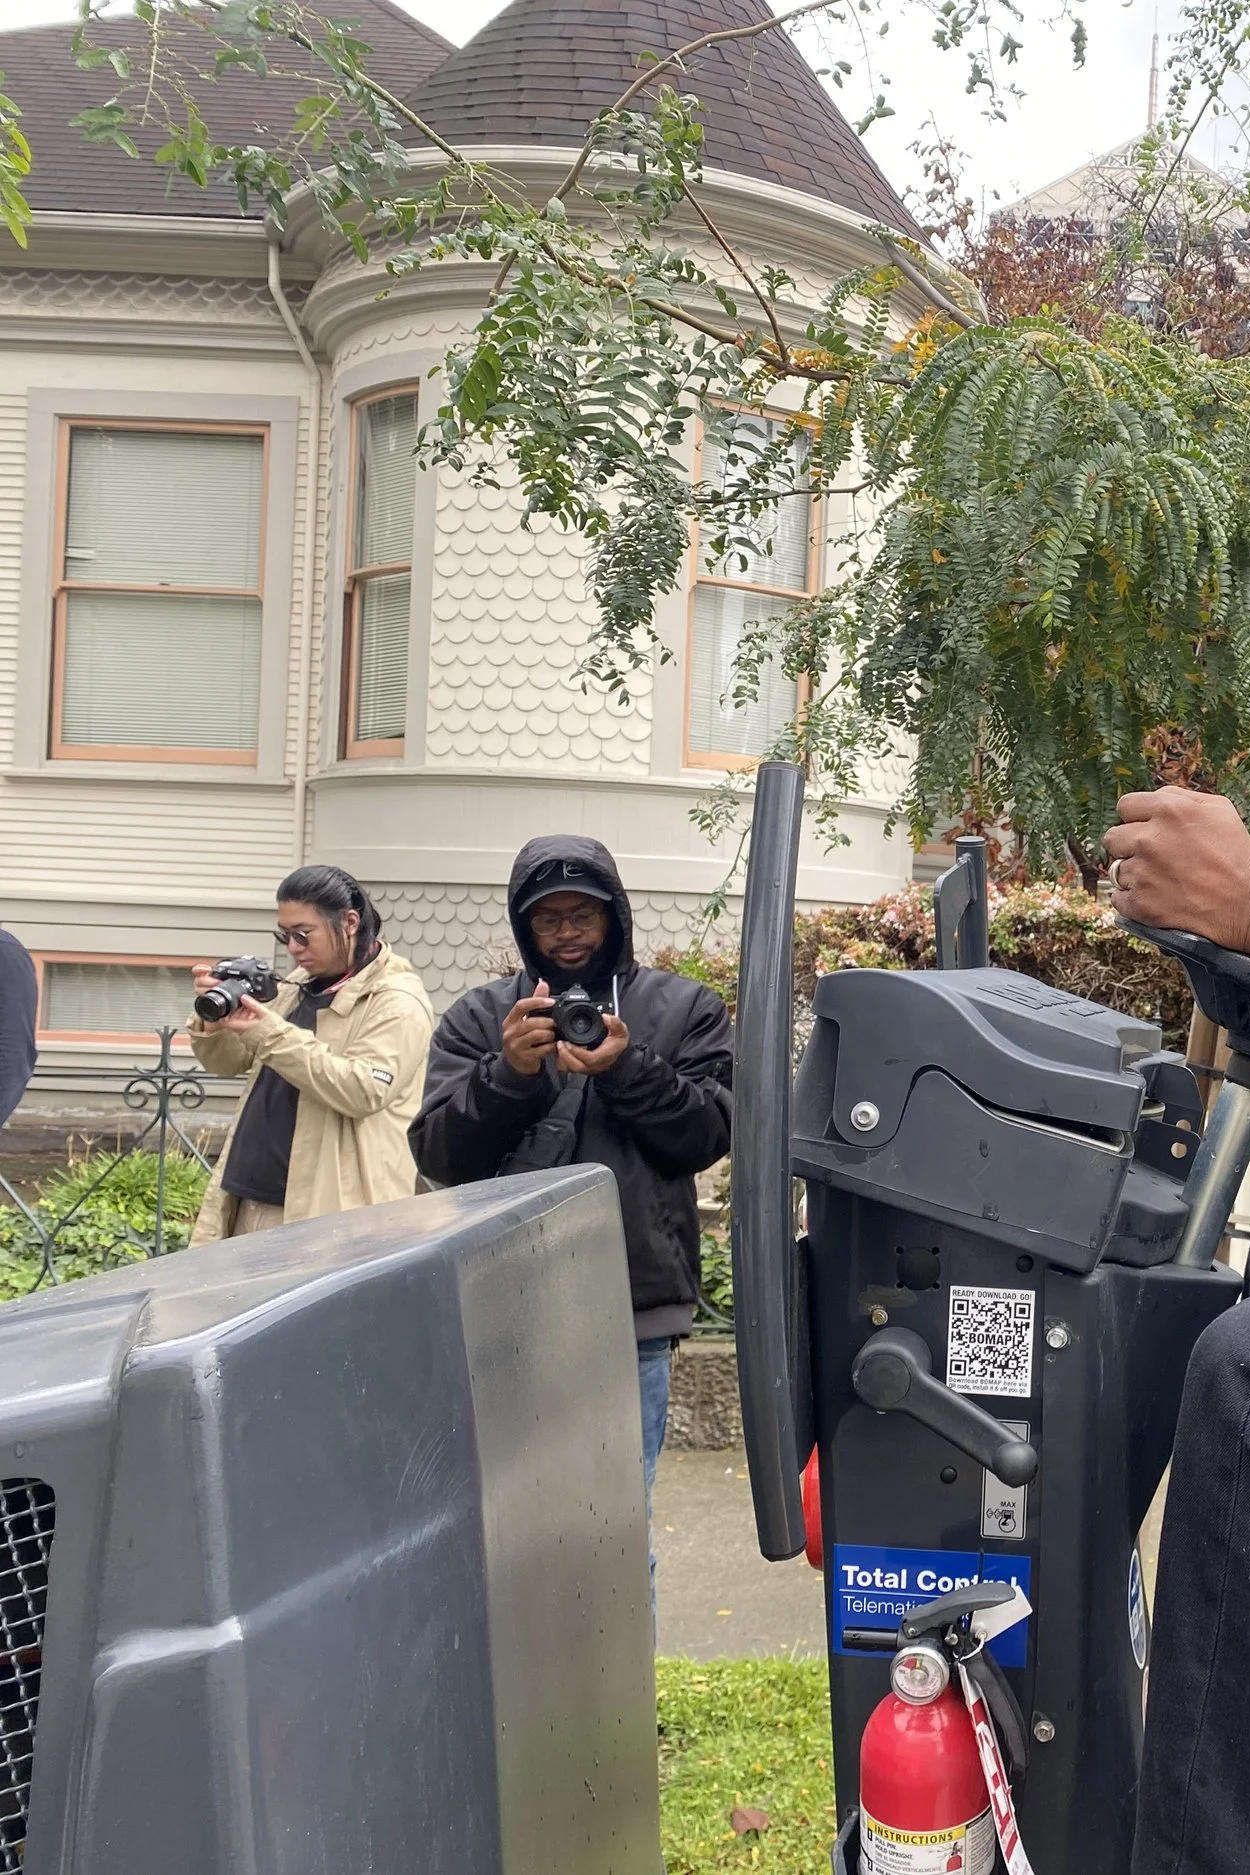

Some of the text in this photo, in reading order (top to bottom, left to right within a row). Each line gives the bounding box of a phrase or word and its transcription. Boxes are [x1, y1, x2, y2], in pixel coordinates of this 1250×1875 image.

[1019, 1293, 1032, 1301] GO!
[968, 1333, 1012, 1346] BOMAP
[948, 1376, 979, 1384] Download
[841, 1565, 907, 1590] Total
[843, 1595, 921, 1617] Telemati
[874, 1824, 953, 1845] INSTRUCTIONS
